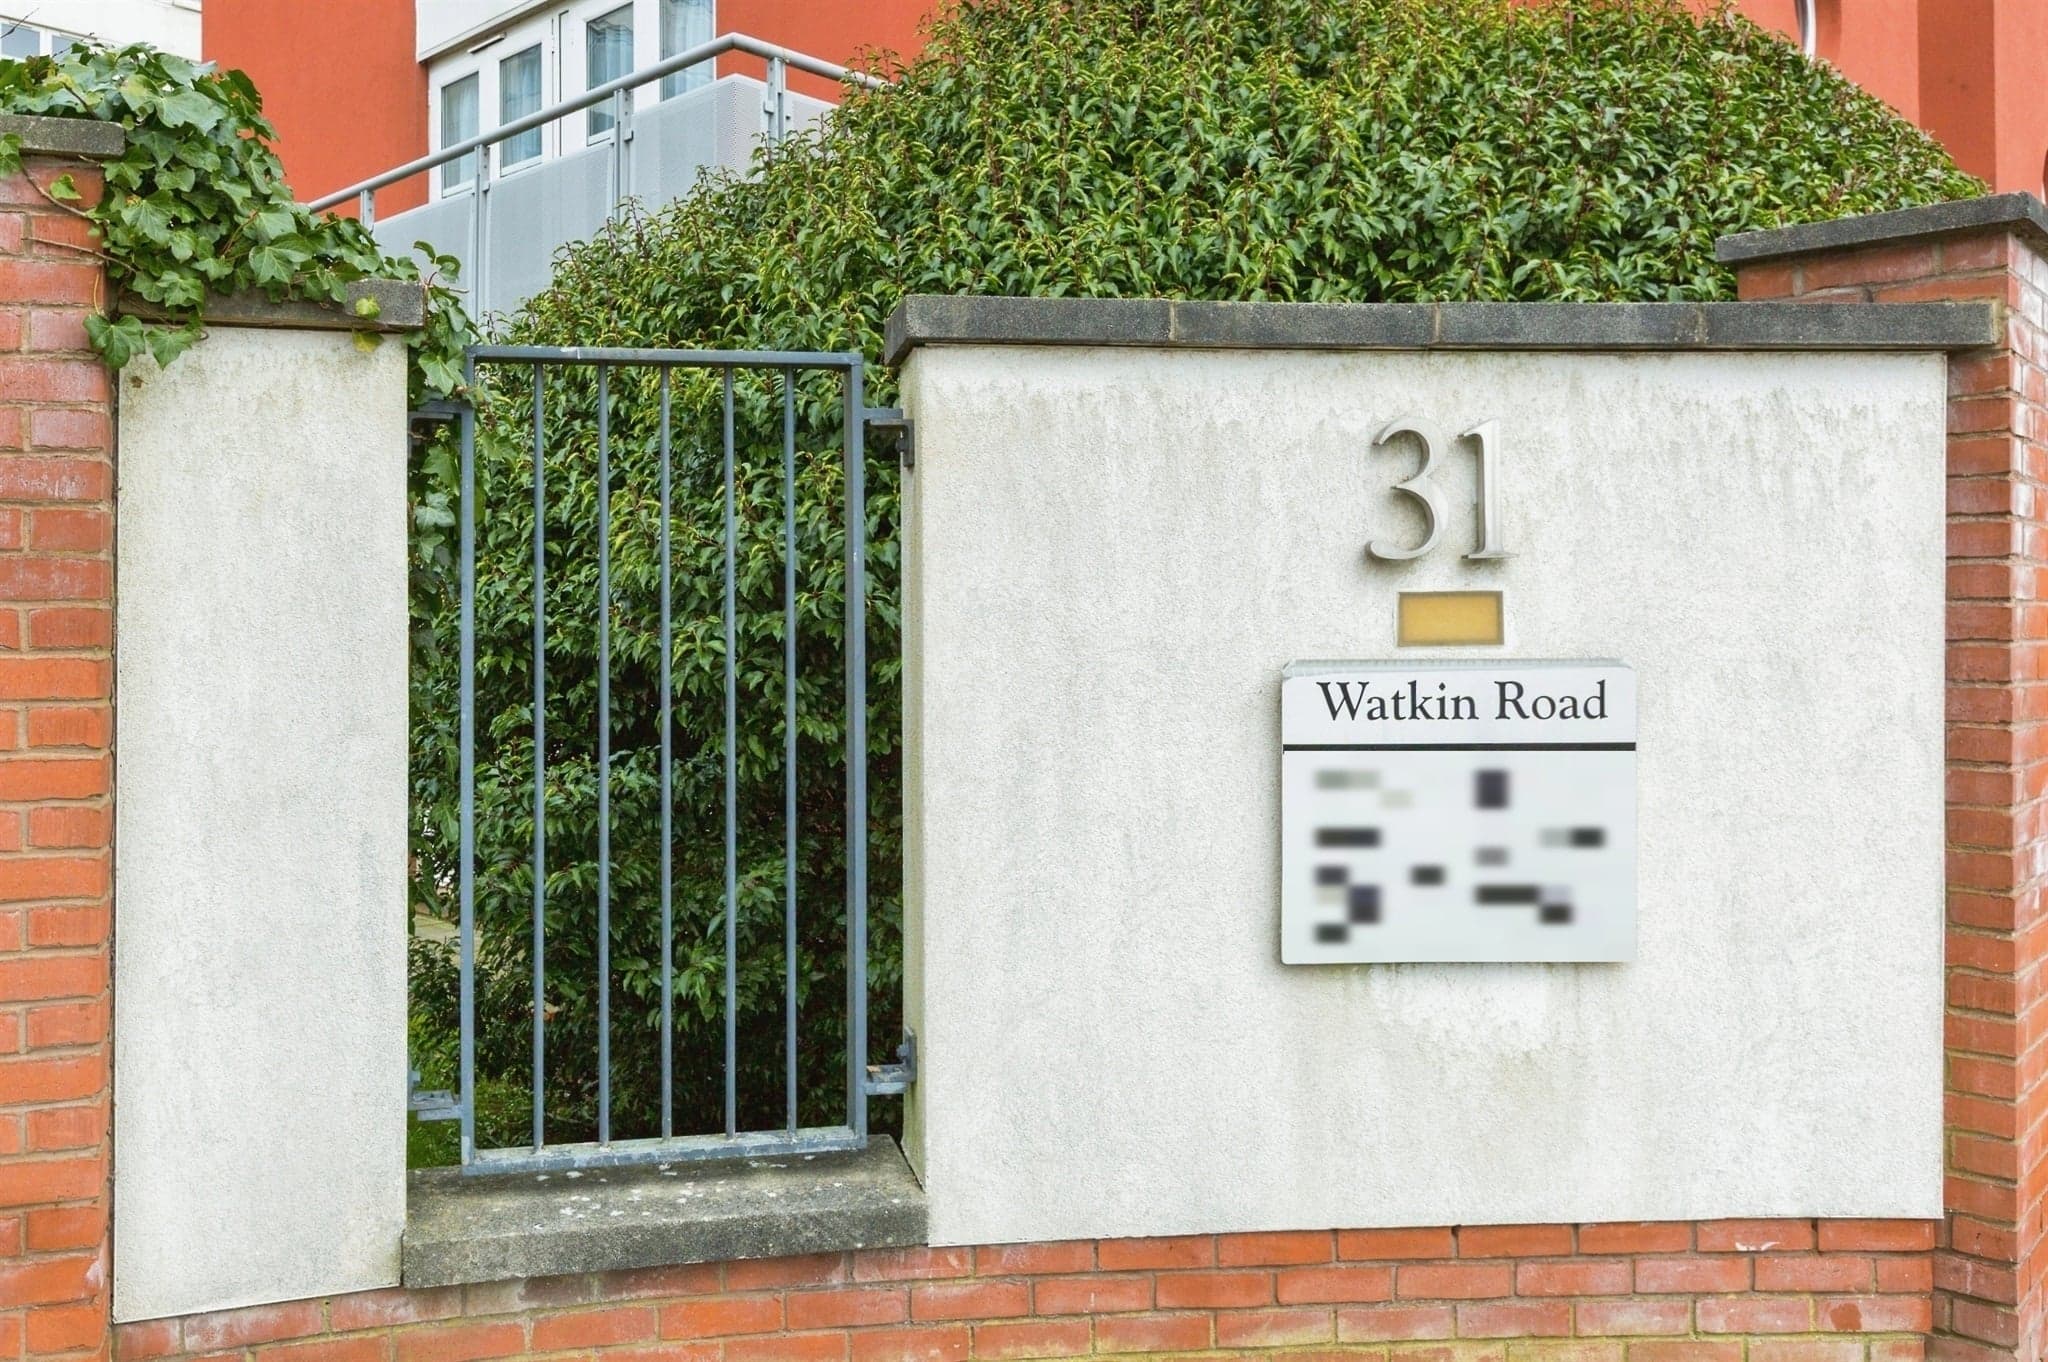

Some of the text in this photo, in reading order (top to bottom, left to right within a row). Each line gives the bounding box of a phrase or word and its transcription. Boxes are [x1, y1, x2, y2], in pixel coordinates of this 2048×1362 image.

[1365, 417, 1519, 560] 31
[1316, 679, 1609, 722] Watkin Road
